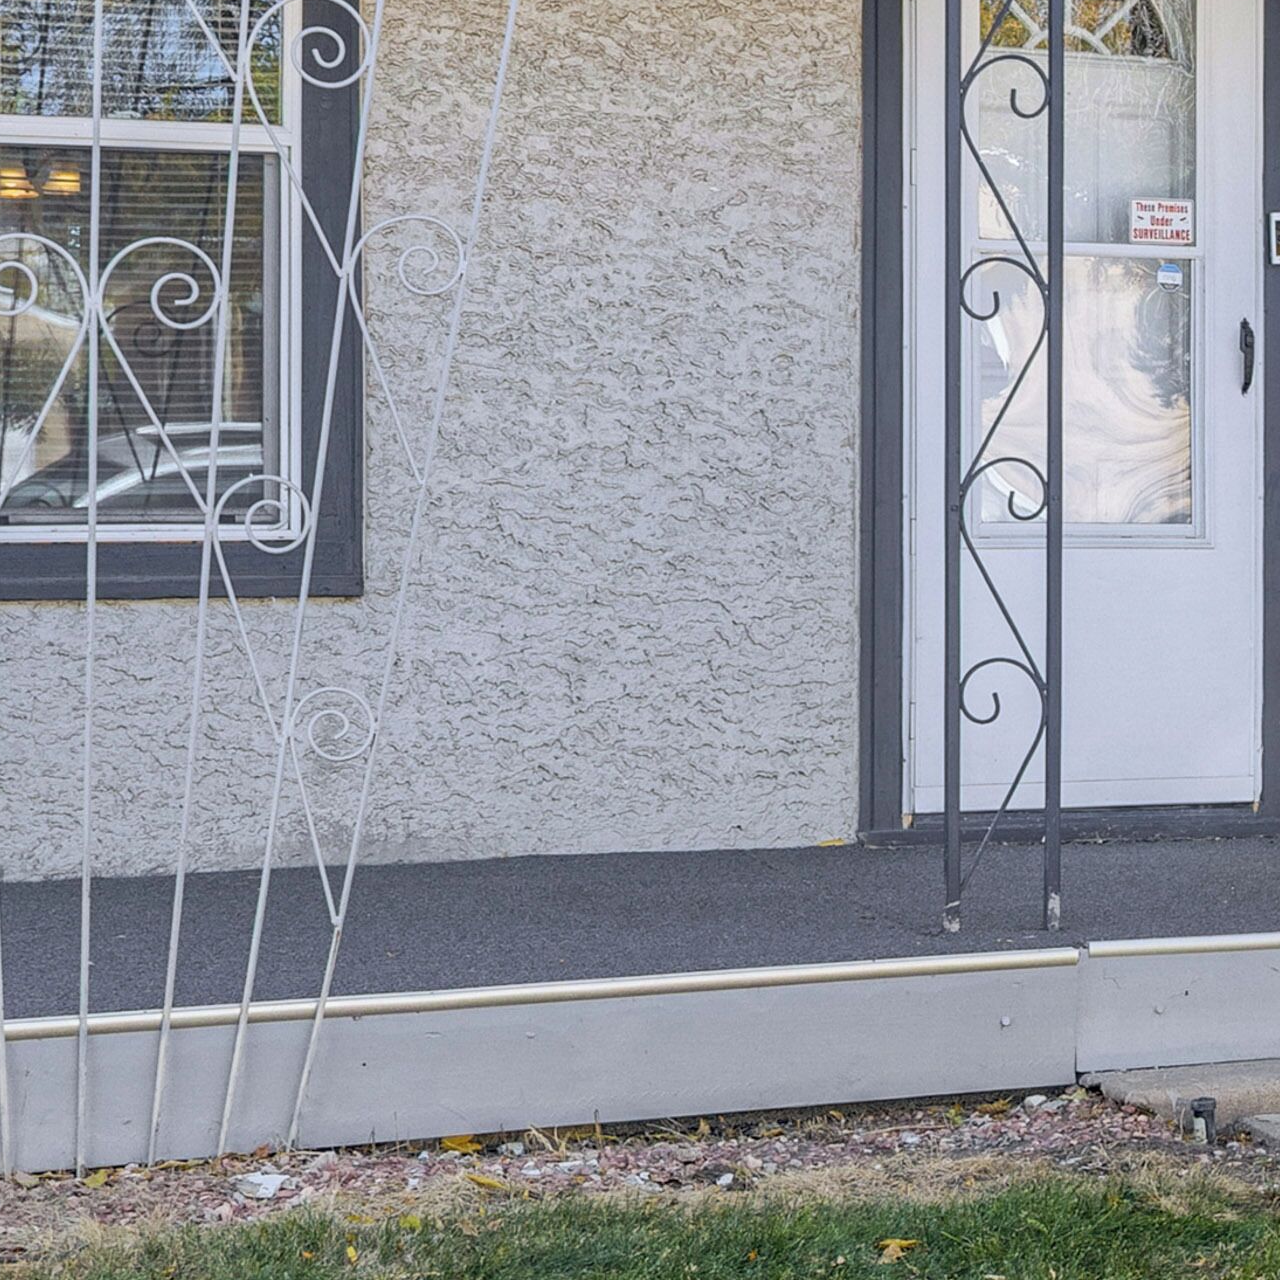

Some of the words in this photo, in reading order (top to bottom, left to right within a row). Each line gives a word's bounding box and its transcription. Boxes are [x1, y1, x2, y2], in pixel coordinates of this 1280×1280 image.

[1136, 202, 1155, 212] These
[1158, 202, 1188, 213] Premises
[1150, 215, 1173, 226] Under
[1133, 228, 1190, 240] SURVEILLANCE
